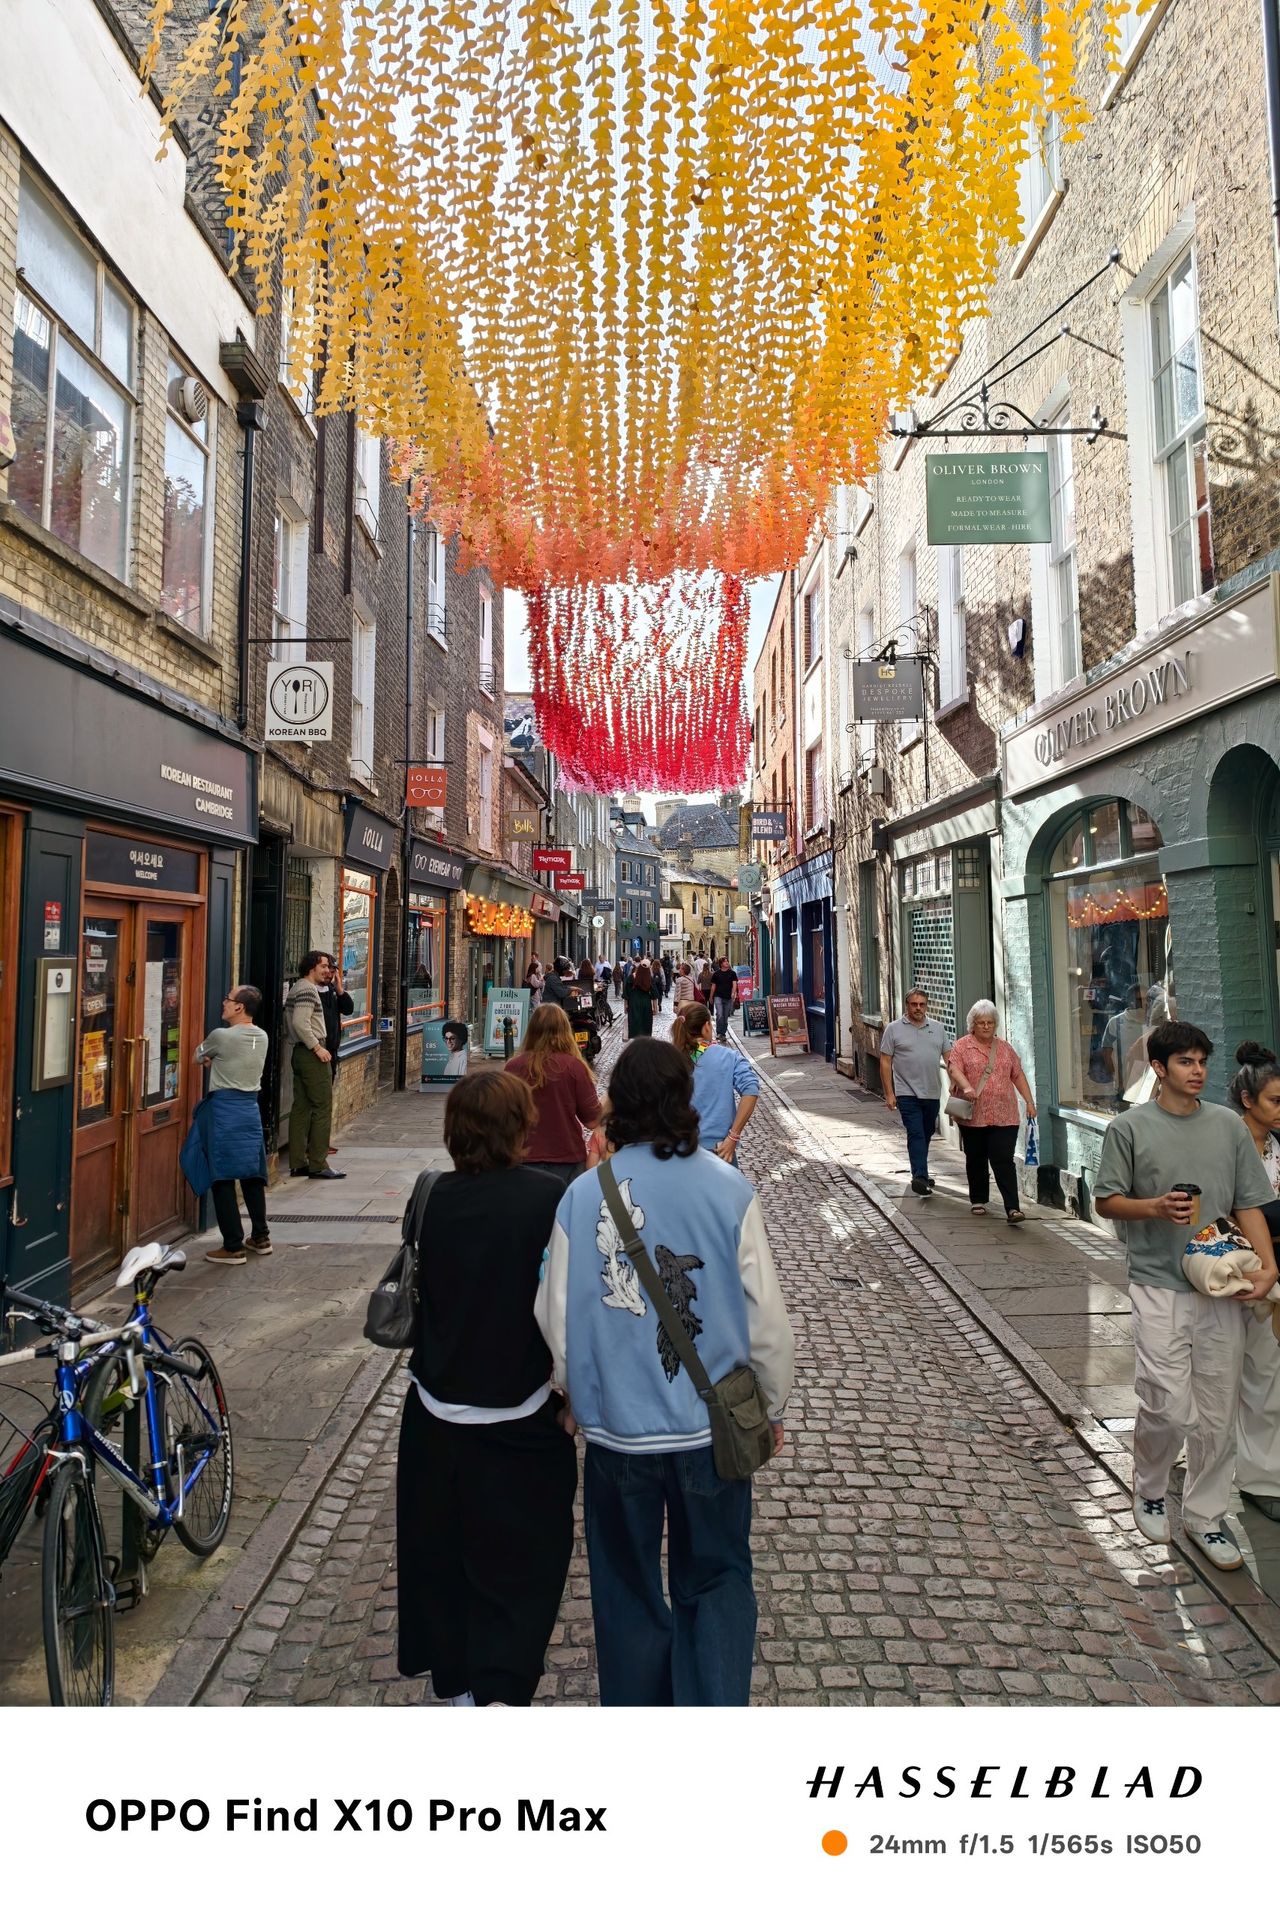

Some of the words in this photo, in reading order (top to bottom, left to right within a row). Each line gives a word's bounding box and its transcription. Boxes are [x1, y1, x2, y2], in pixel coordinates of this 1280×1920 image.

[933, 464, 985, 475] OLIVER
[991, 463, 1042, 474] BROWN
[1034, 705, 1100, 767] OLIVER
[1104, 650, 1192, 731] BROWN
[269, 728, 306, 736] KOREAN
[308, 728, 327, 736] BBQ
[161, 764, 191, 787] KOREAN
[192, 775, 233, 801] RESTAURANT
[195, 797, 233, 820] CAMBRIDGE
[752, 826, 773, 834] BLEND
[129, 850, 164, 868] 어서오세요
[135, 869, 158, 881] WELCOME
[428, 858, 451, 877] EYEWEAR
[87, 1000, 104, 1011] OPEN
